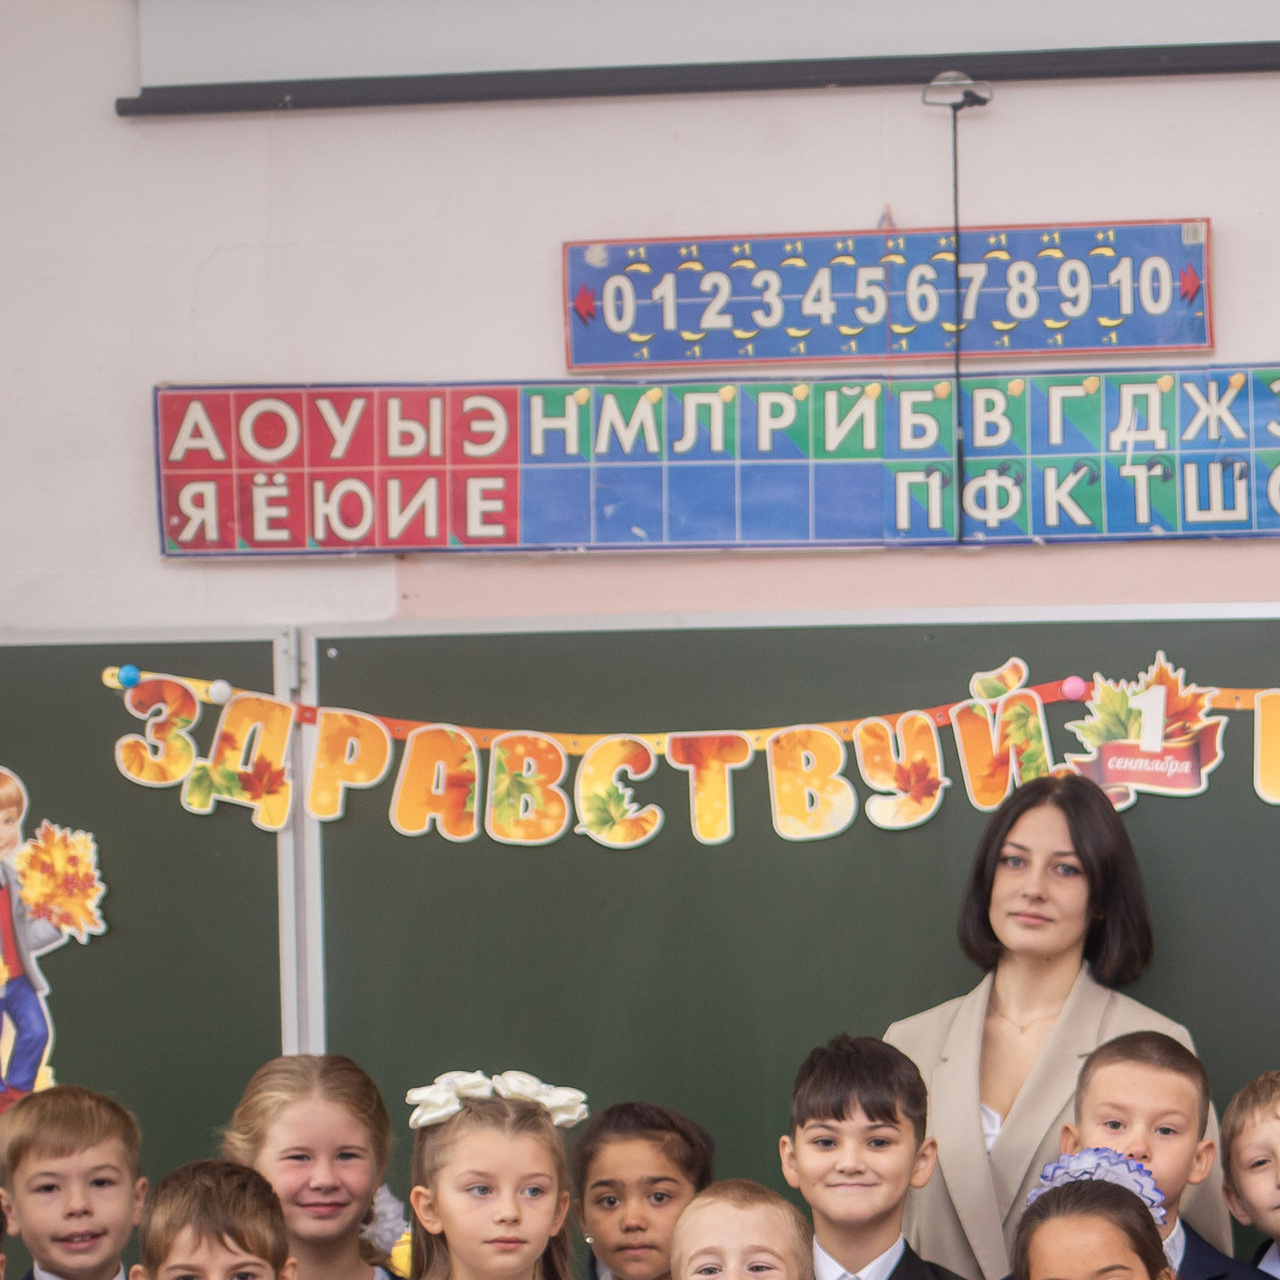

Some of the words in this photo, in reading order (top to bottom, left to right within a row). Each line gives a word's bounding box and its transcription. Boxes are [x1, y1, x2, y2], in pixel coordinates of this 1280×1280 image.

[602, 274, 636, 334] 0
[652, 273, 677, 331] 1
[700, 271, 733, 329] 2
[751, 269, 785, 329] 3
[802, 267, 836, 325] 4
[854, 267, 888, 325] 5
[906, 264, 939, 323] 6
[957, 263, 988, 320] 7
[1006, 260, 1040, 320] 8
[1058, 259, 1091, 318] 9
[1108, 256, 1173, 315] 10
[168, 400, 227, 462] А
[239, 397, 300, 463] О
[314, 398, 366, 459] У
[387, 397, 443, 458] Ы
[462, 395, 509, 457] Э
[529, 394, 579, 456] Н
[594, 393, 661, 454] М
[673, 392, 725, 453] Л
[758, 391, 797, 452] Р
[824, 386, 877, 452] Й
[899, 391, 940, 450] Б
[972, 388, 1013, 449] В
[1048, 385, 1088, 446] Г
[1108, 383, 1167, 452] Д
[1180, 381, 1249, 442] Ж
[177, 481, 219, 542] Я
[252, 471, 291, 541] Ё
[312, 477, 375, 541] Ю
[386, 477, 439, 539] И
[466, 476, 506, 538] Е
[895, 469, 943, 530] П
[962, 469, 1022, 529] Ф
[1044, 465, 1096, 528] К
[1119, 464, 1164, 526] Т
[1183, 462, 1250, 523] Ш
[115, 657, 1082, 847] ЗДРАВСТВУЙ
[1129, 684, 1168, 754] 1
[1107, 755, 1192, 778] сентября
